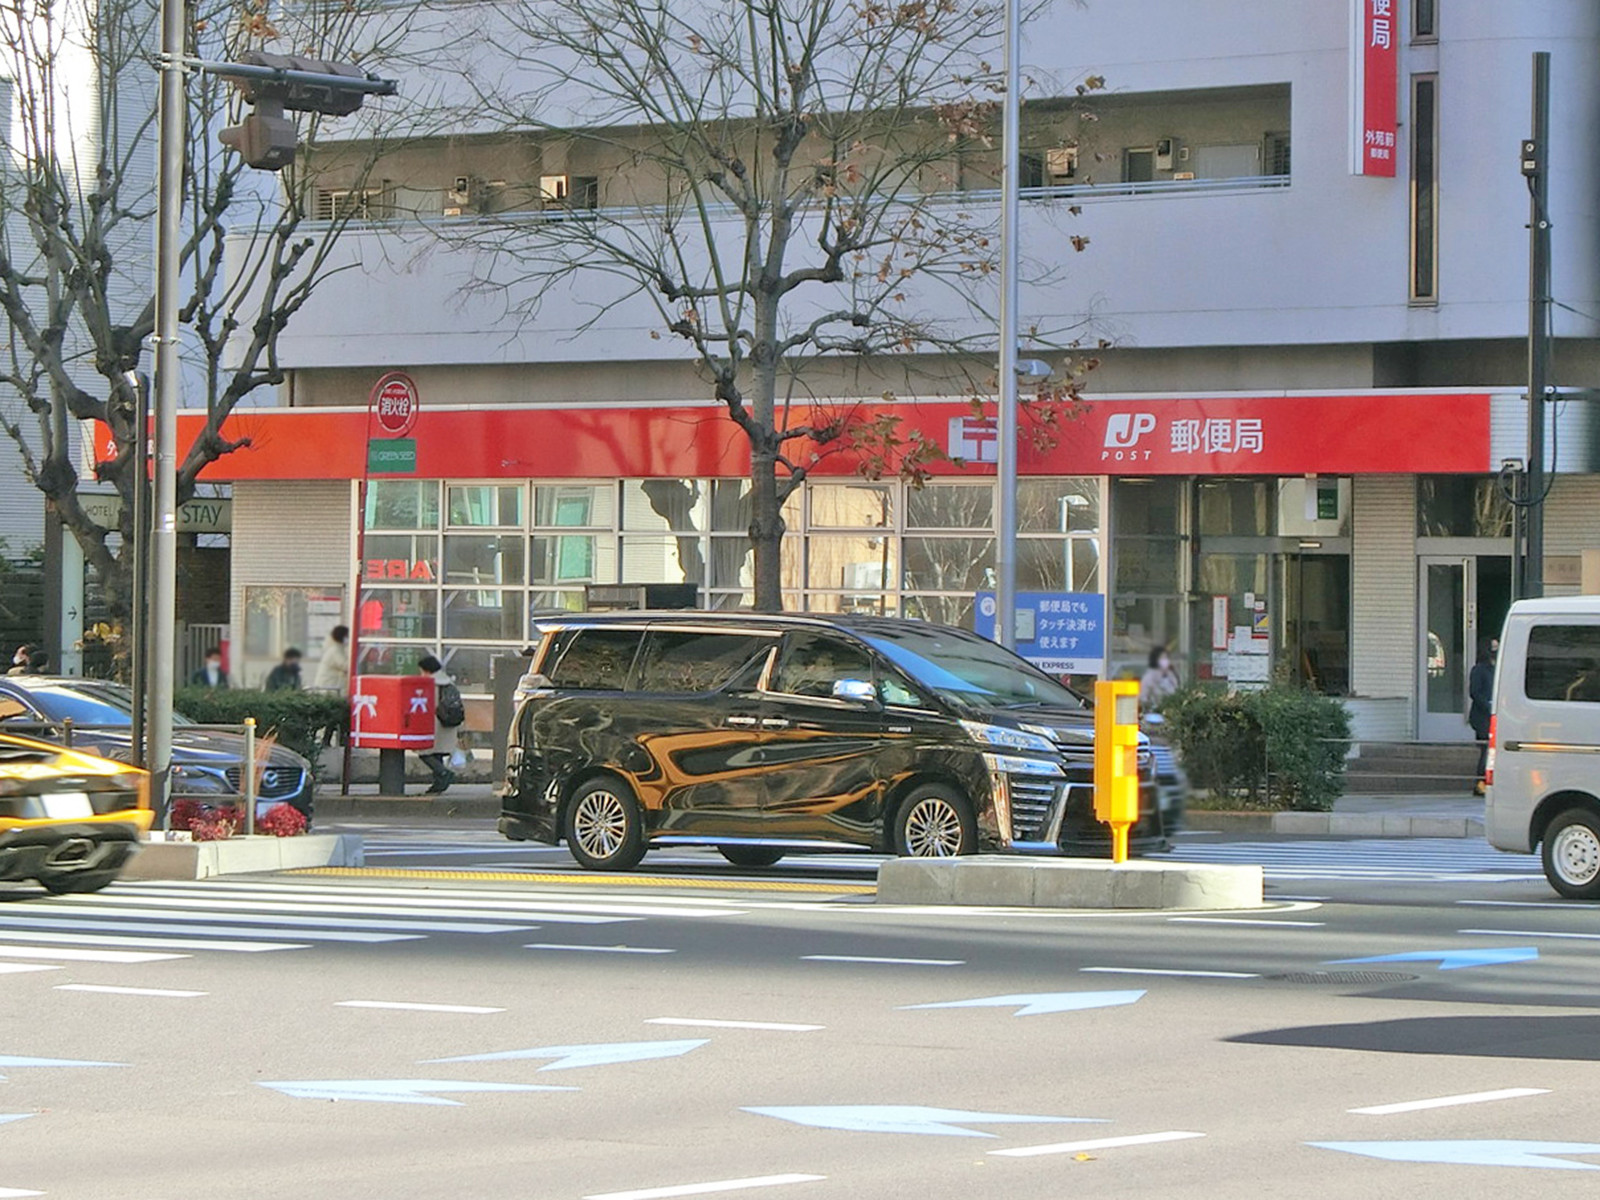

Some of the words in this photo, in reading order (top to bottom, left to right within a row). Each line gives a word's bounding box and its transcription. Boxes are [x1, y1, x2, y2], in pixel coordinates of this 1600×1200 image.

[1365, 129, 1394, 147] 外苑前
[381, 397, 409, 416] 消火栓
[1170, 418, 1264, 454] 郵便局
[1101, 450, 1151, 461] POST
[182, 504, 223, 526] STAY
[1040, 600, 1088, 614] 郵便局でも
[1040, 619, 1097, 632] タッチ決済が
[1040, 636, 1079, 650] 使えます
[1042, 661, 1075, 670] EXPRESS
